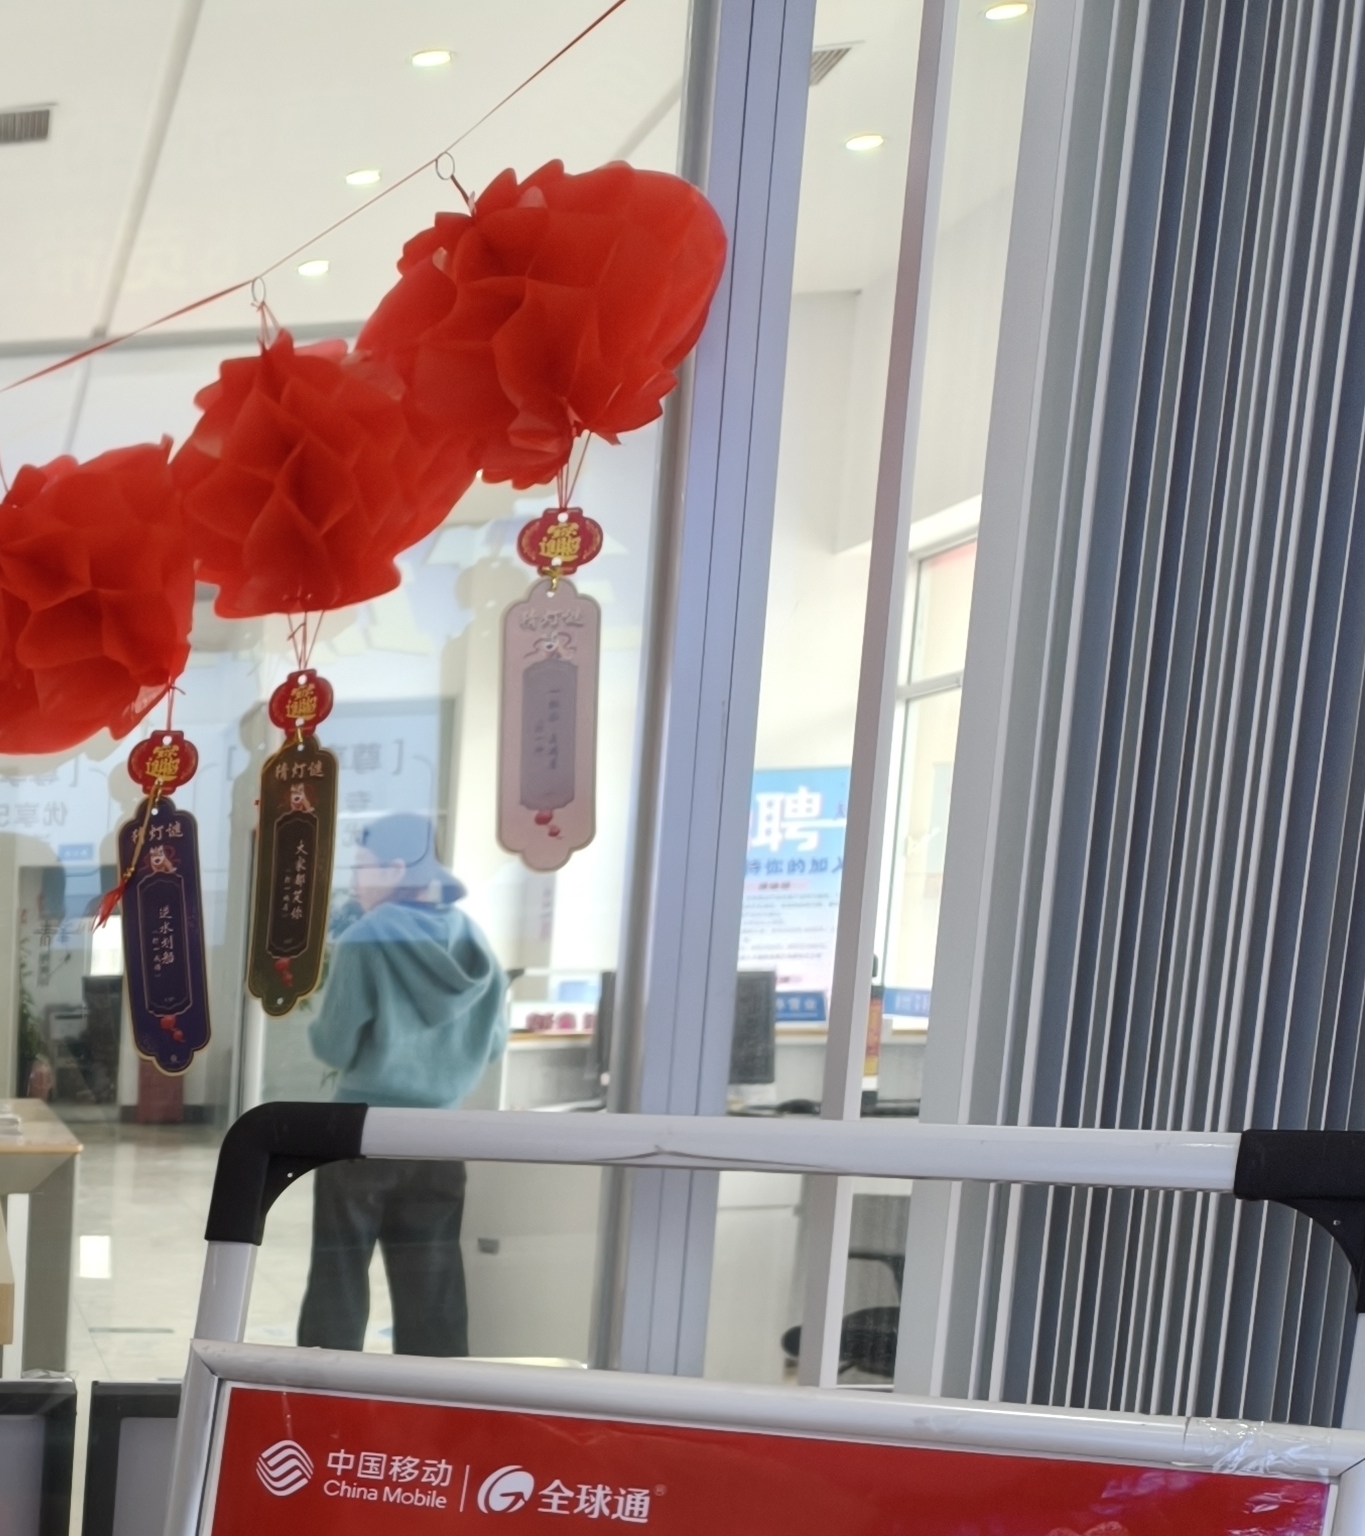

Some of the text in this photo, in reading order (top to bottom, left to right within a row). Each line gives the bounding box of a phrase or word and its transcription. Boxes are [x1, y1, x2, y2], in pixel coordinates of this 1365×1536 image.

[275, 761, 325, 780] 猜灯谜
[323, 1480, 448, 1510] China Mobile
[326, 1449, 652, 1524] 中国移动 全球通
